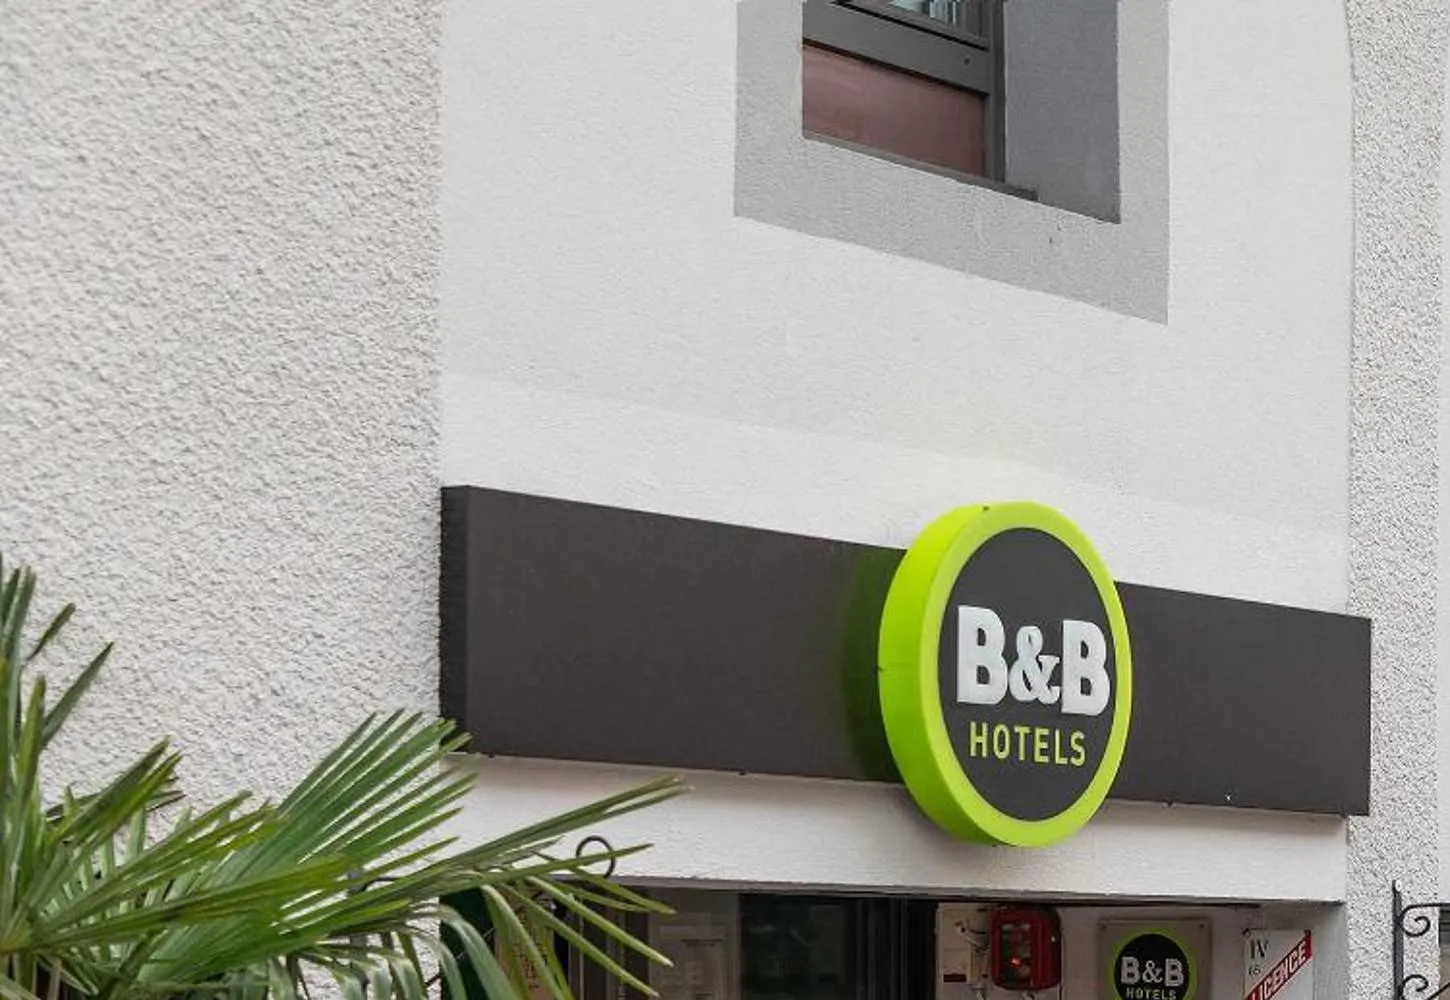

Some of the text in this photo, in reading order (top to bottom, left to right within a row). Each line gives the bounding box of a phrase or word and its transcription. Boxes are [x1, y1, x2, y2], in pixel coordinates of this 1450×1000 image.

[956, 604, 1111, 716] B&B
[969, 720, 1086, 766] HOTELS
[1249, 939, 1269, 959] IV
[1120, 956, 1184, 987] B&B
[1126, 987, 1177, 1000] HOTELS
